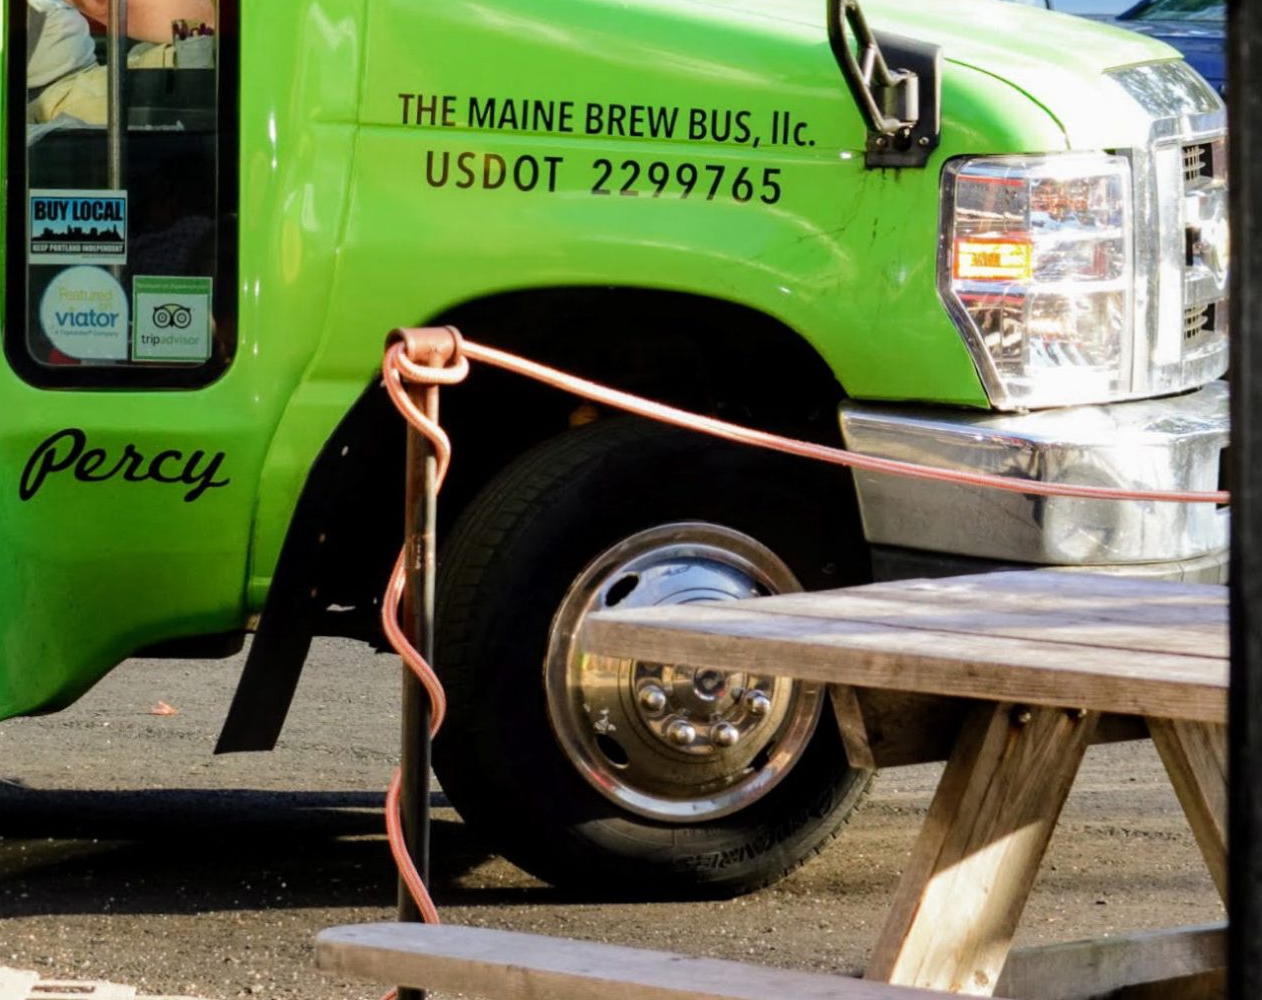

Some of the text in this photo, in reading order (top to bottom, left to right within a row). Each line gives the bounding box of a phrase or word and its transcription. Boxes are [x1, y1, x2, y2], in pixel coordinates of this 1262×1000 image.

[398, 92, 457, 128] THE
[468, 96, 575, 134] MAINE
[585, 102, 680, 140] BREW
[688, 107, 762, 149] BUS,
[425, 149, 784, 205] USDOT 2299765
[34, 200, 123, 221] BUY LOCAL
[55, 306, 120, 328] viator
[141, 333, 200, 347] tripadvisor
[19, 427, 231, 502] Percy
